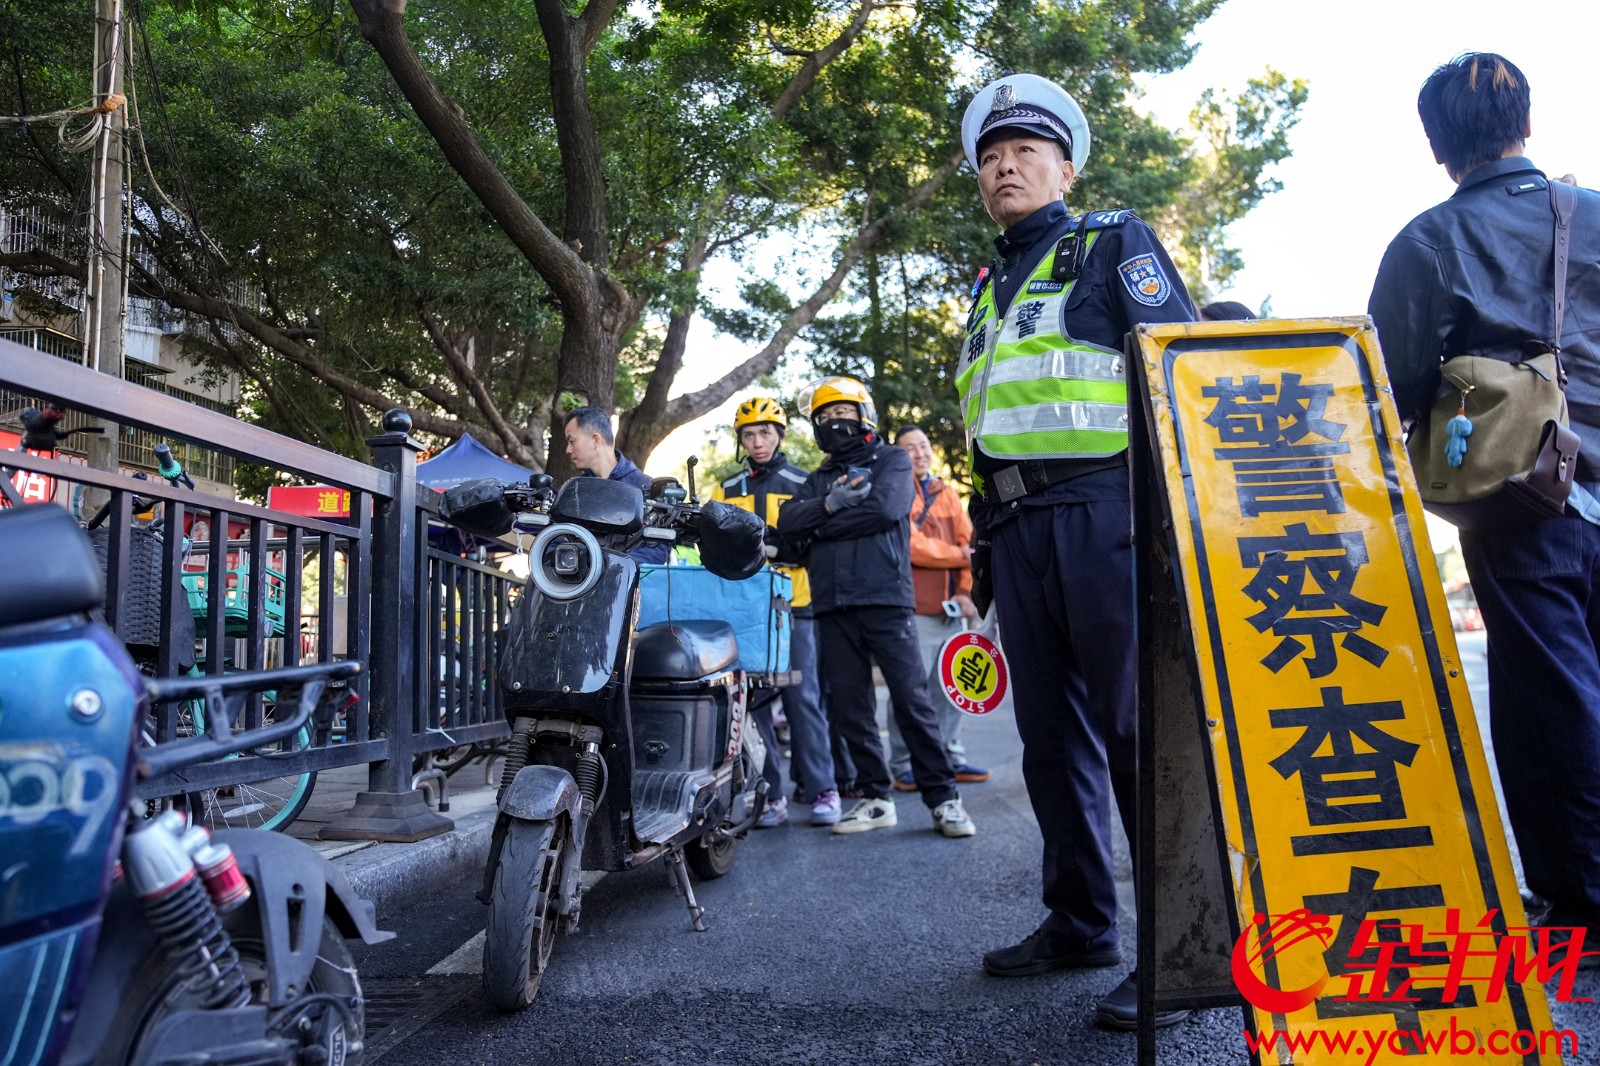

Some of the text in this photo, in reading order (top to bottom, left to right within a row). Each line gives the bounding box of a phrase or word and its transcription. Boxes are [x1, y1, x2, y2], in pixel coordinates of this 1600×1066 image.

[1015, 300, 1046, 340] 警
[956, 651, 991, 695] 停
[946, 684, 985, 713] STOP
[1200, 371, 1479, 1056] 警察查车
